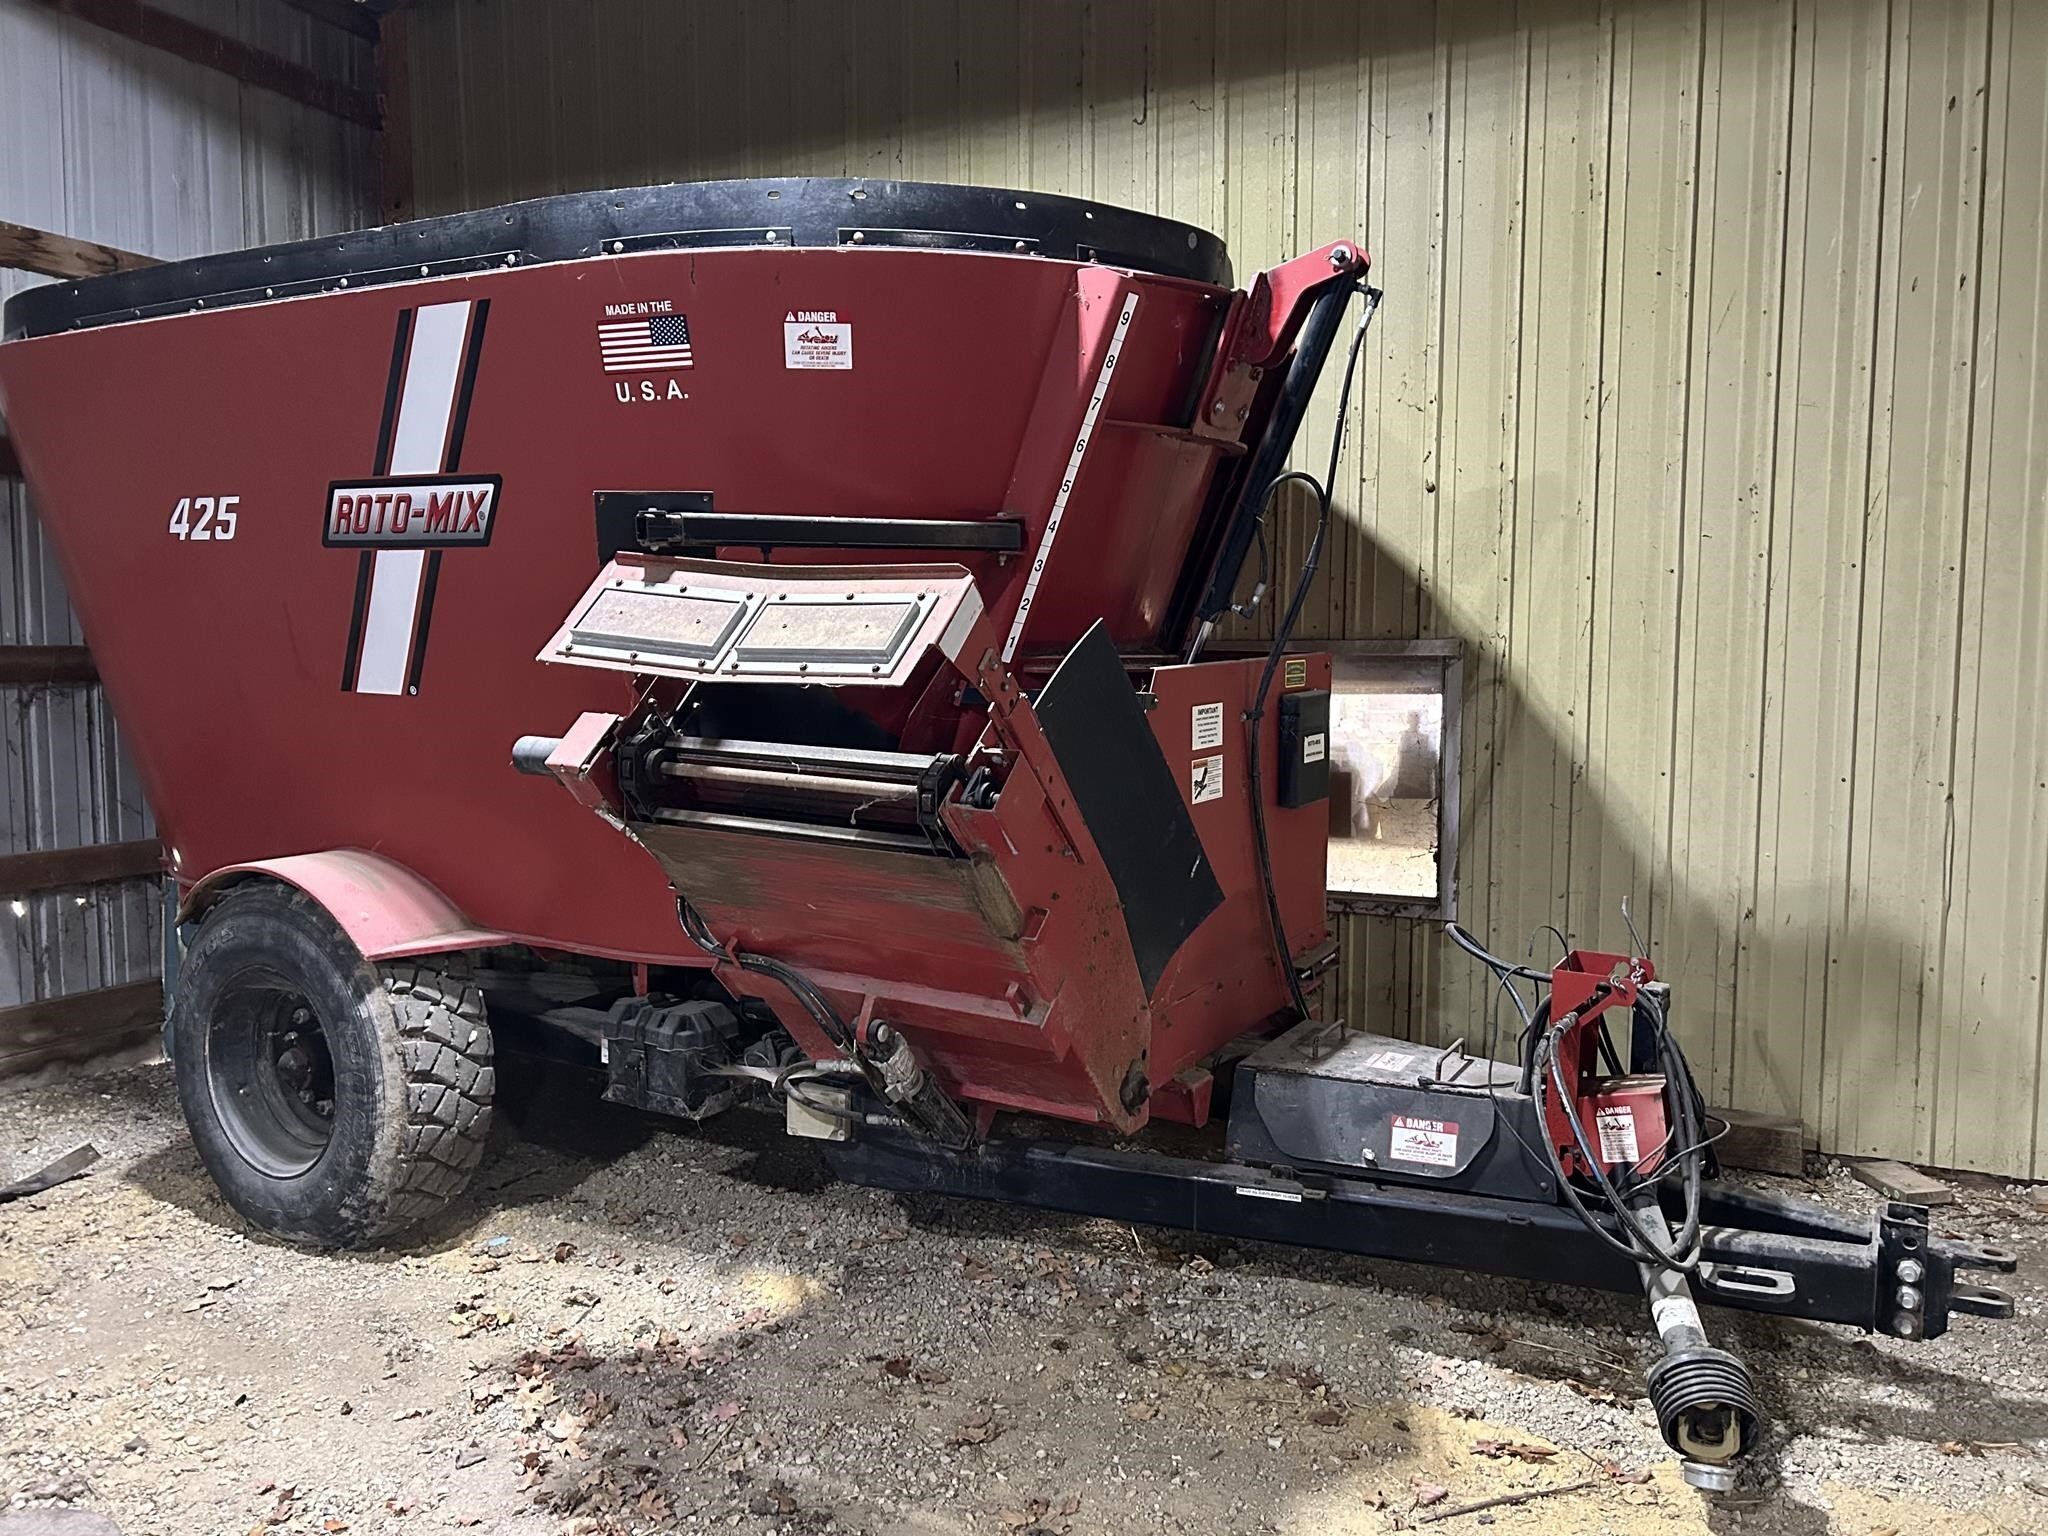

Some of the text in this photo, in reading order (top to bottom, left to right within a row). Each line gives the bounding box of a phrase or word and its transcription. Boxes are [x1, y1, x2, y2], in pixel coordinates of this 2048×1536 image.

[605, 300, 673, 316] MADE IN THE
[797, 311, 837, 322] DANGER
[1121, 311, 1130, 326] 9
[1106, 354, 1116, 369] 8
[615, 379, 689, 403] U. S. A.
[1092, 397, 1102, 411] 7
[1076, 439, 1086, 453] 6
[1062, 479, 1072, 493] 5
[168, 495, 240, 541] 425
[1048, 520, 1057, 534] 4
[1034, 559, 1044, 572] 3
[1021, 597, 1030, 611] 2
[1009, 636, 1016, 649] 1
[1197, 706, 1218, 715] IMPORTANT
[1604, 1105, 1632, 1115] DANGER
[1406, 1117, 1444, 1133] DANGER
